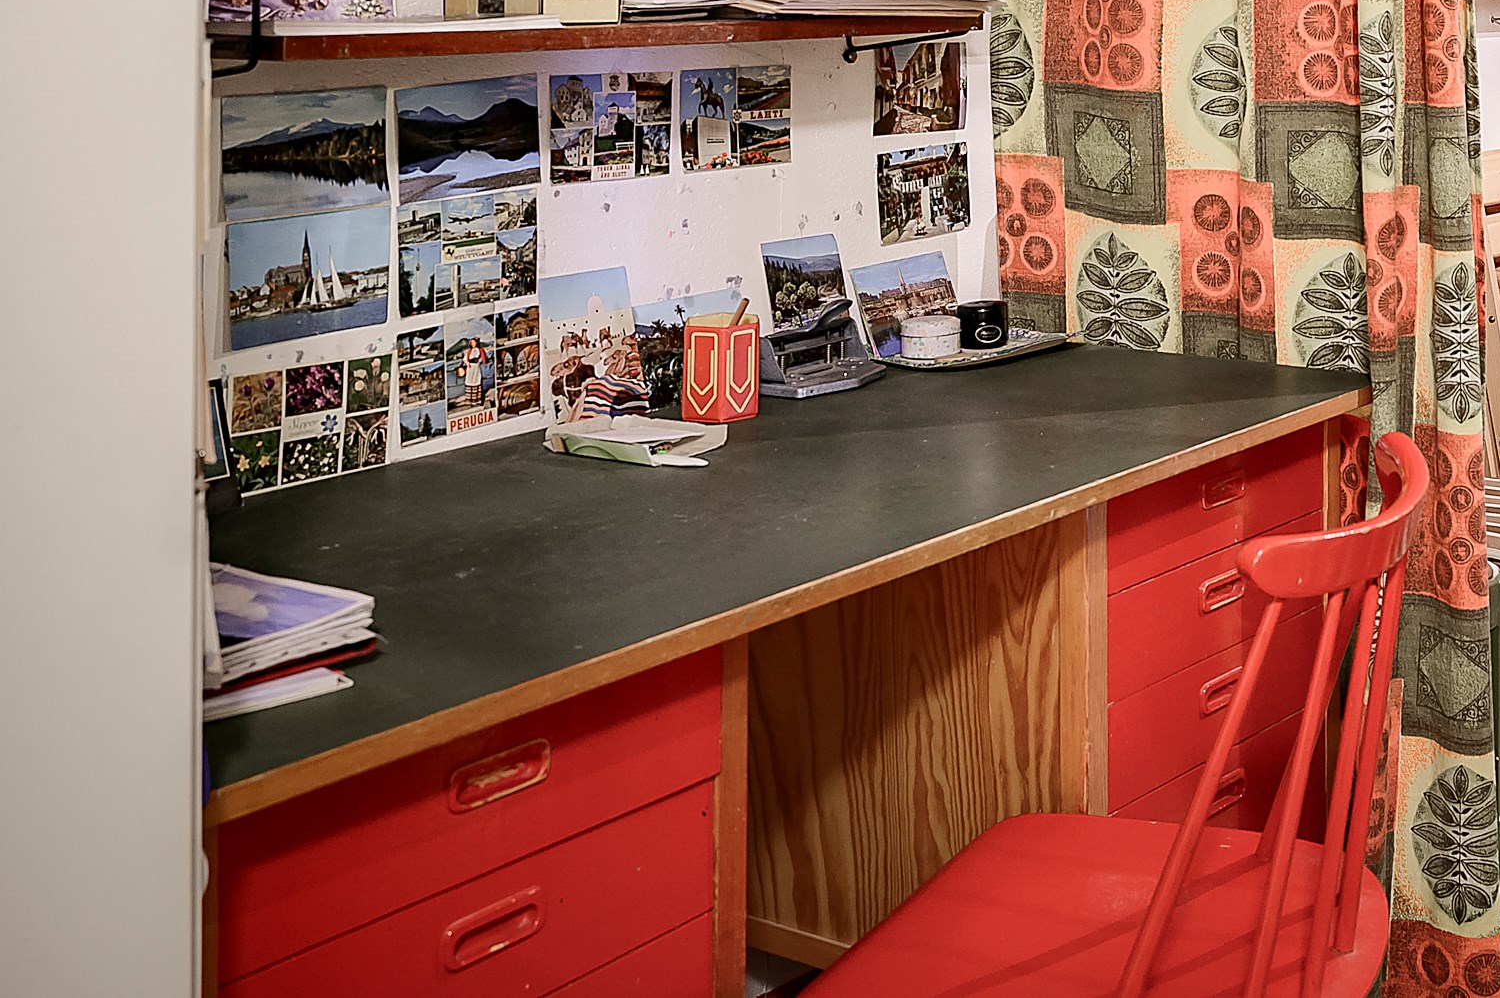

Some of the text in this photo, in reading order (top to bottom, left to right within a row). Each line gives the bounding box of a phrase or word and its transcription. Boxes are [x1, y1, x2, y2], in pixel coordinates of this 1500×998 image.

[750, 110, 783, 119] LAHTI
[454, 250, 493, 260] STUTTGART
[450, 410, 494, 432] PERUGIA
